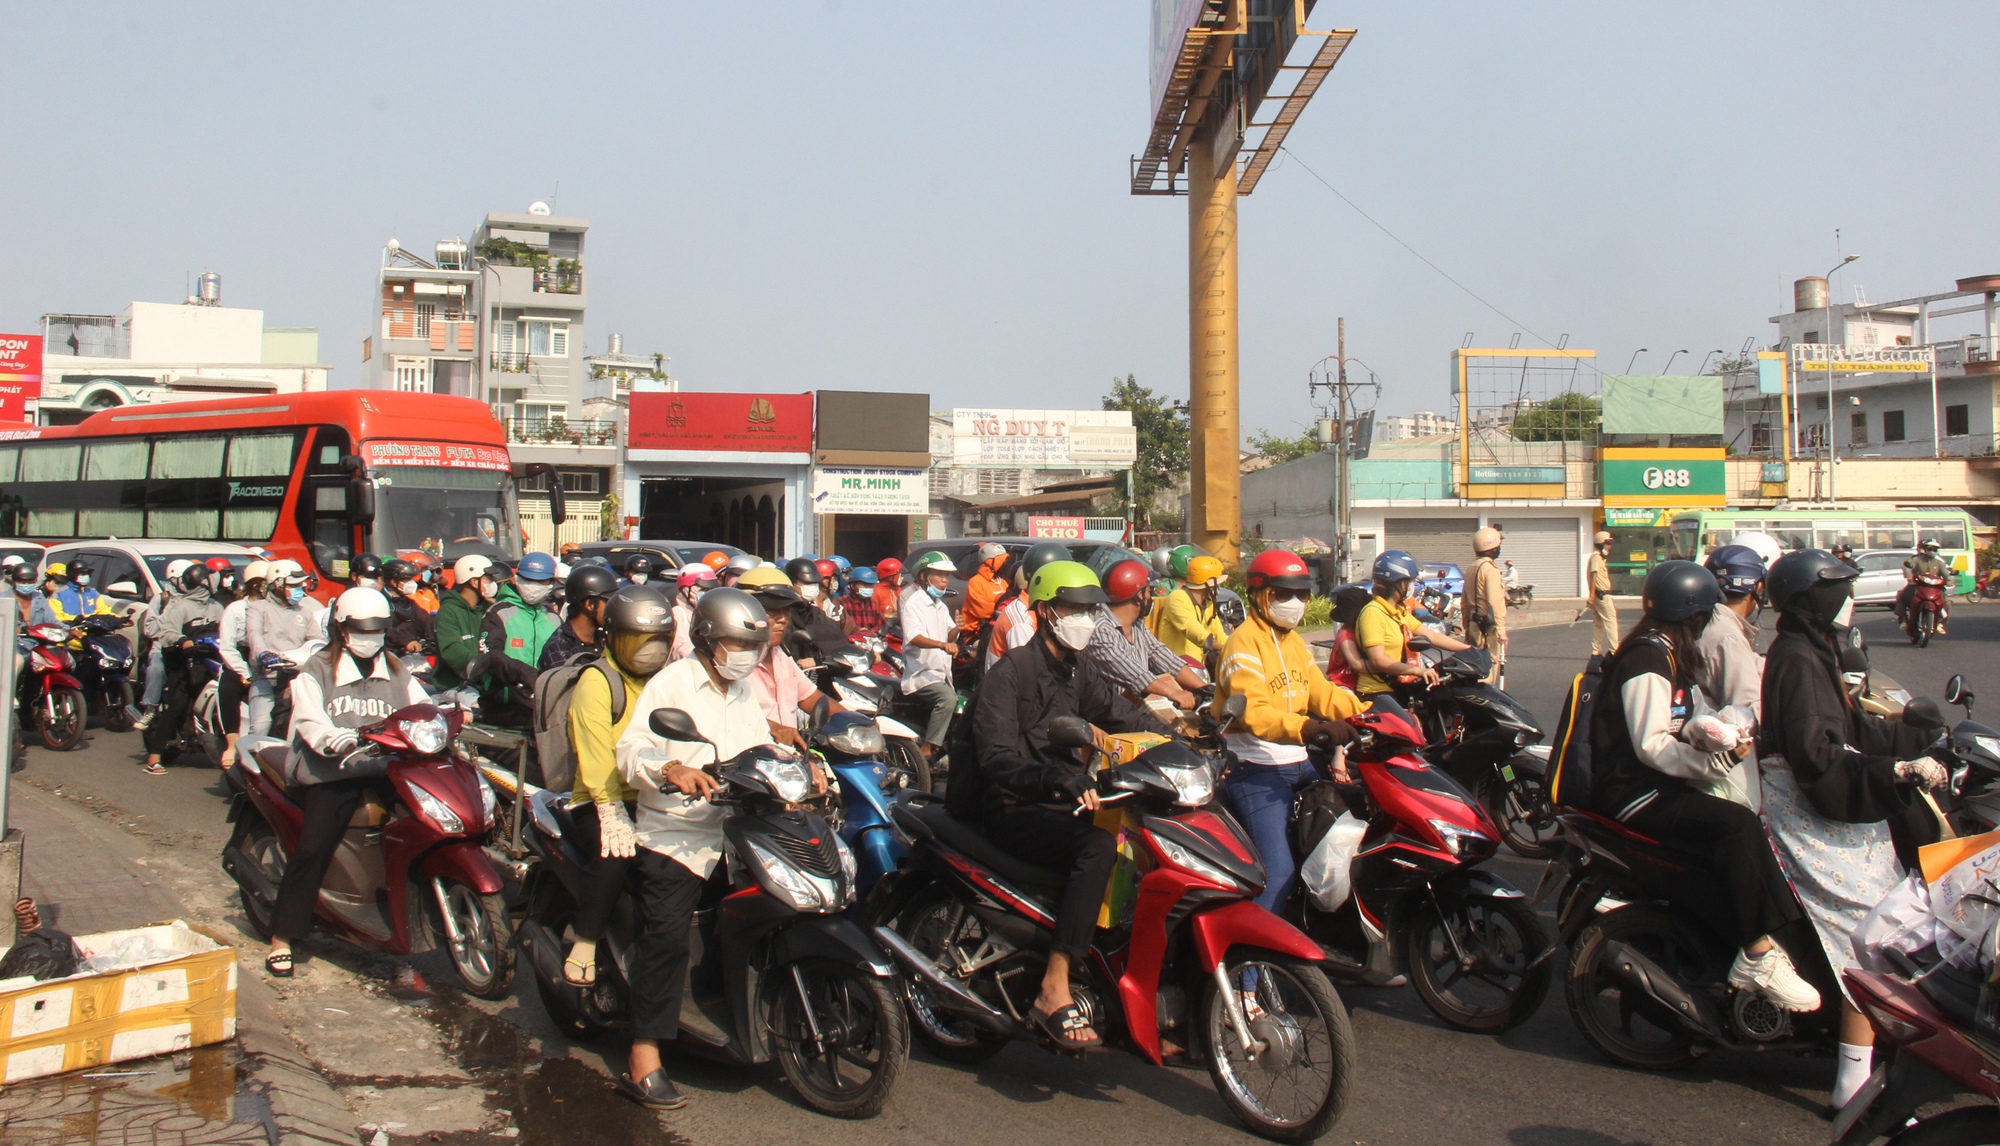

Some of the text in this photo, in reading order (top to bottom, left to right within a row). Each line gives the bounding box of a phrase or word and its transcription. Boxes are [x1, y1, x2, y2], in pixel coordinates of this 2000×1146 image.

[410, 445, 440, 457] TRANG
[446, 447, 475, 459] FUTA
[372, 456, 390, 465] BẾN
[841, 478, 901, 490] MR.MINH
[228, 482, 284, 501] TRACOMECO
[1036, 528, 1078, 538] KHO
[327, 695, 398, 719] YMBOLI
